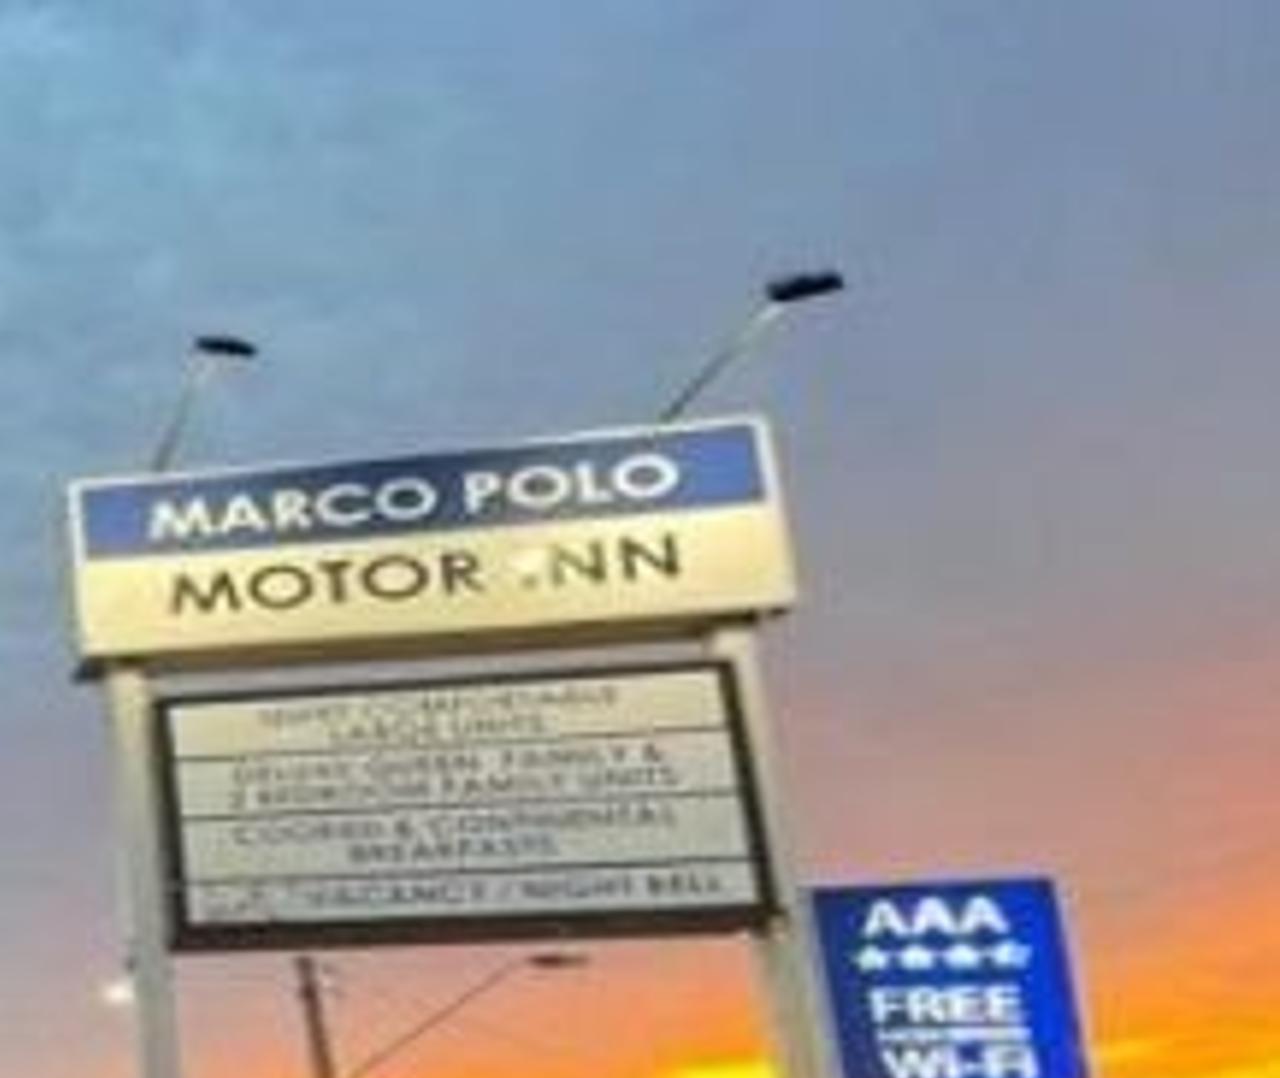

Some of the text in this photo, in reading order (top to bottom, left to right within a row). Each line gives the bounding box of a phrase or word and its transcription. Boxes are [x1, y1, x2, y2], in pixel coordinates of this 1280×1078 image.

[148, 453, 680, 540] MARCO POLO
[170, 533, 682, 614] MOTOR NN
[579, 764, 679, 788] UNITS
[864, 897, 1011, 935] AAA
[869, 985, 1026, 1023] FREE
